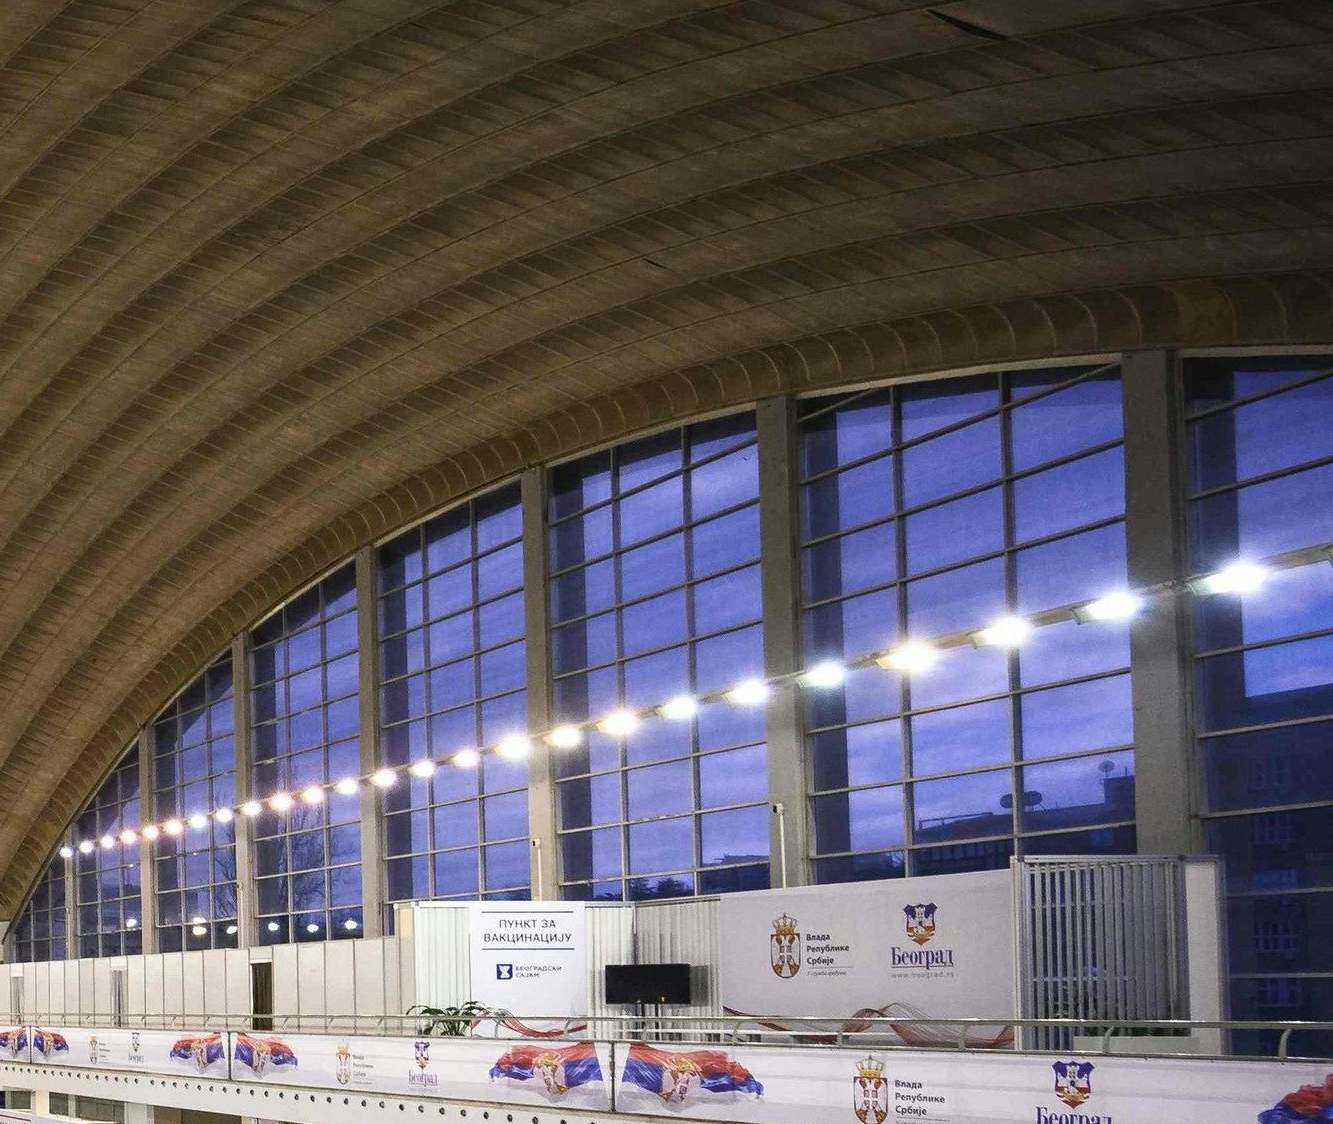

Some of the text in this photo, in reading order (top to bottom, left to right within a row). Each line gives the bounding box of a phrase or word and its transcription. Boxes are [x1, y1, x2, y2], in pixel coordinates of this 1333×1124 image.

[499, 919, 556, 929] ПУНКТ ЗА
[484, 933, 572, 944] ВАКЦИНАЦИЈУ
[806, 933, 831, 941] Влада
[806, 944, 850, 954] Републике
[806, 956, 835, 966] Србије
[891, 946, 954, 970] Београд
[515, 965, 562, 973] БЕОГРАДСКИ
[891, 971, 955, 979] www.beograd.rs
[894, 1079, 923, 1090] Влада
[895, 1092, 946, 1104] Републике
[895, 1105, 928, 1117] Србије
